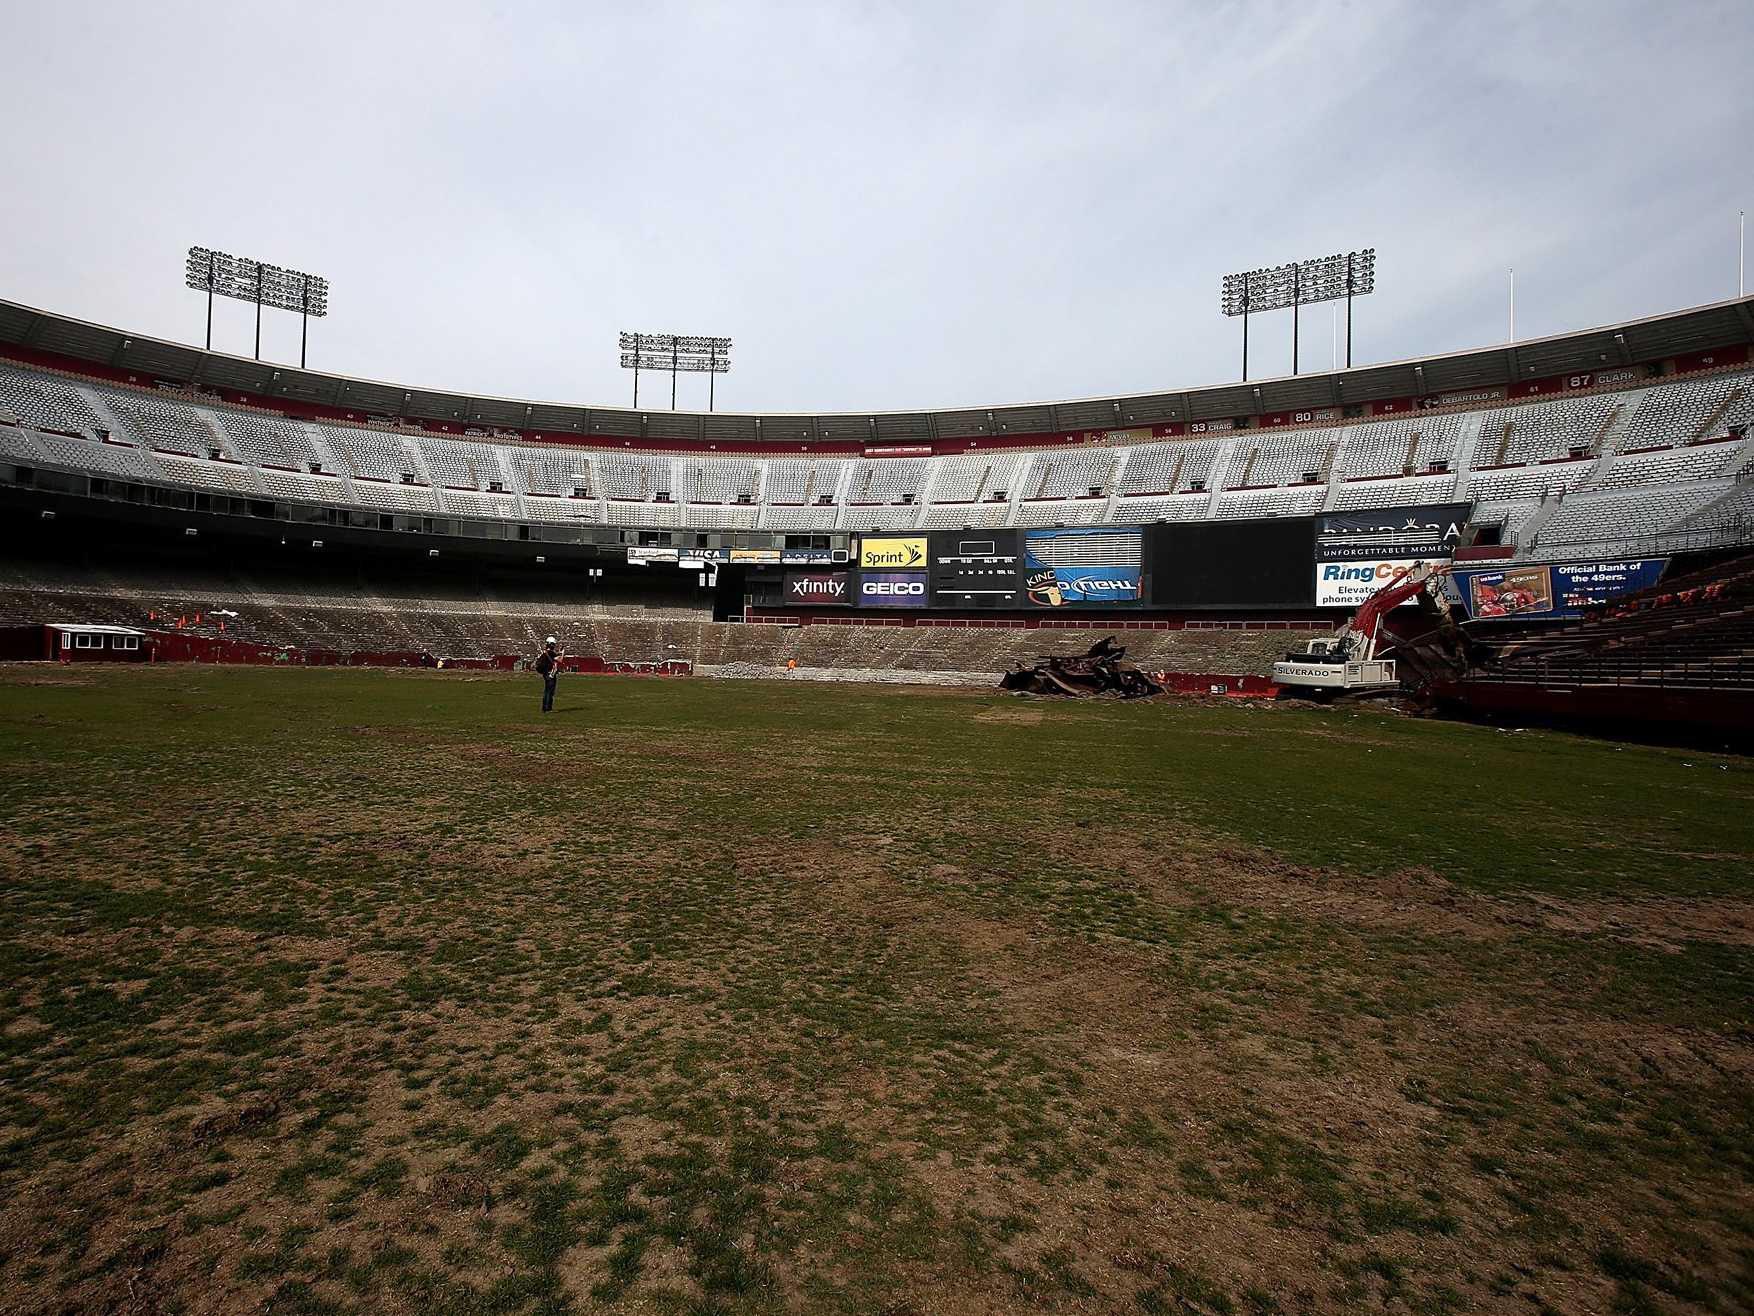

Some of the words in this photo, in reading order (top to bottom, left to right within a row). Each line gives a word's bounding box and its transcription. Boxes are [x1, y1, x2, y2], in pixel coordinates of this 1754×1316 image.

[1570, 374, 1591, 387] 87
[1295, 412, 1311, 422] 80
[1316, 412, 1335, 420] RICE
[1191, 423, 1206, 433] 33
[1208, 423, 1232, 431] CRAIG
[1323, 547, 1406, 557] UNFORGETTABLE
[865, 551, 904, 567] Sprint
[1558, 564, 1596, 575] Official
[1598, 562, 1627, 573] Bank
[1629, 562, 1642, 571] of
[1590, 573, 1627, 582] 49ers.
[863, 582, 925, 595] GEICO
[1338, 586, 1376, 595] Elevate
[1322, 595, 1353, 605] phone
[1278, 666, 1330, 677] SILVERADO
